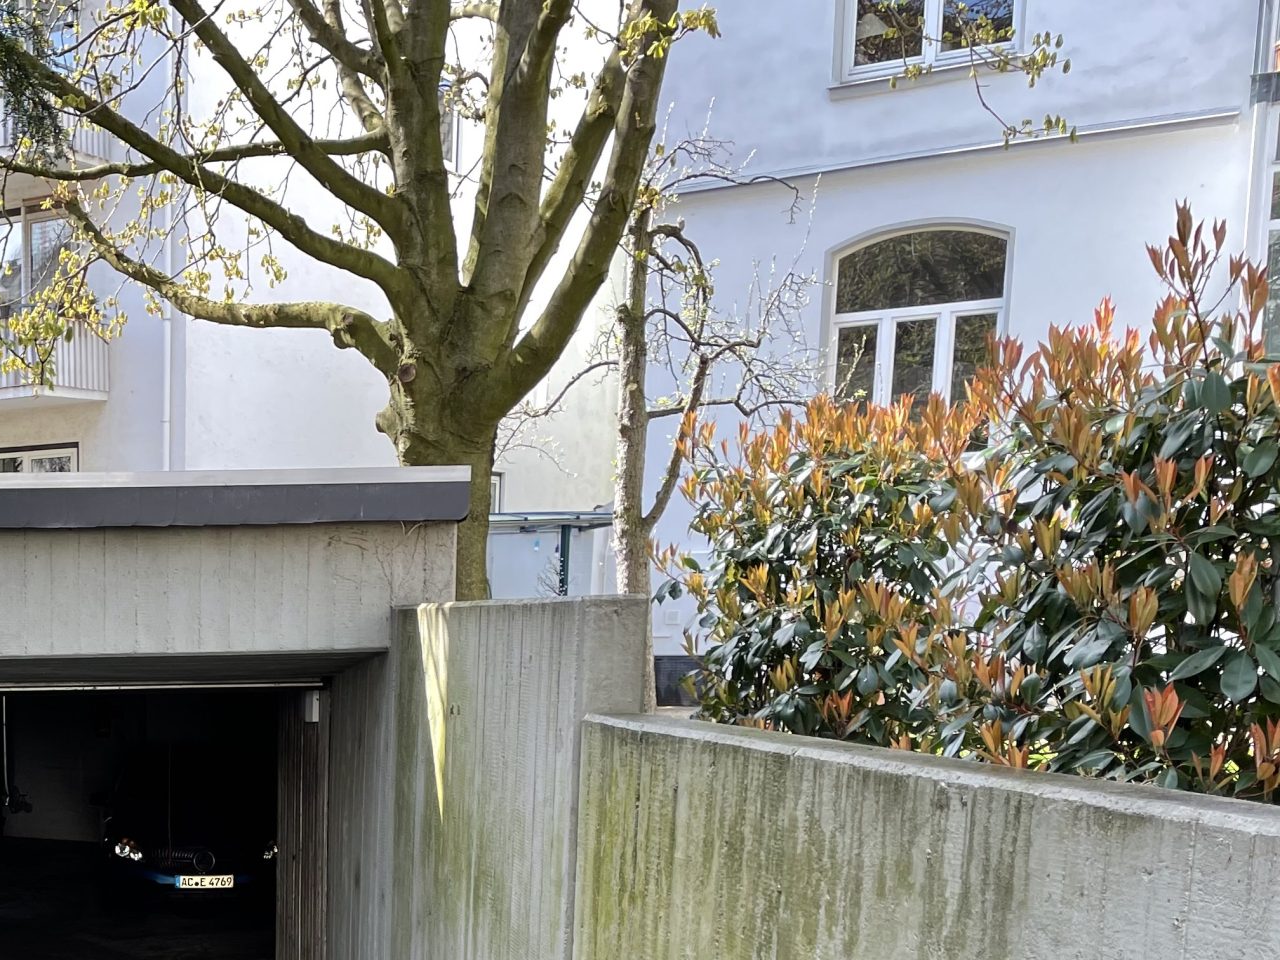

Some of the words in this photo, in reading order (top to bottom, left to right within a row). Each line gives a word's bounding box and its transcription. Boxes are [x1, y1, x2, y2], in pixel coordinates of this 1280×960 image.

[181, 877, 194, 887] AC
[200, 877, 206, 887] E
[208, 876, 233, 887] 4769
